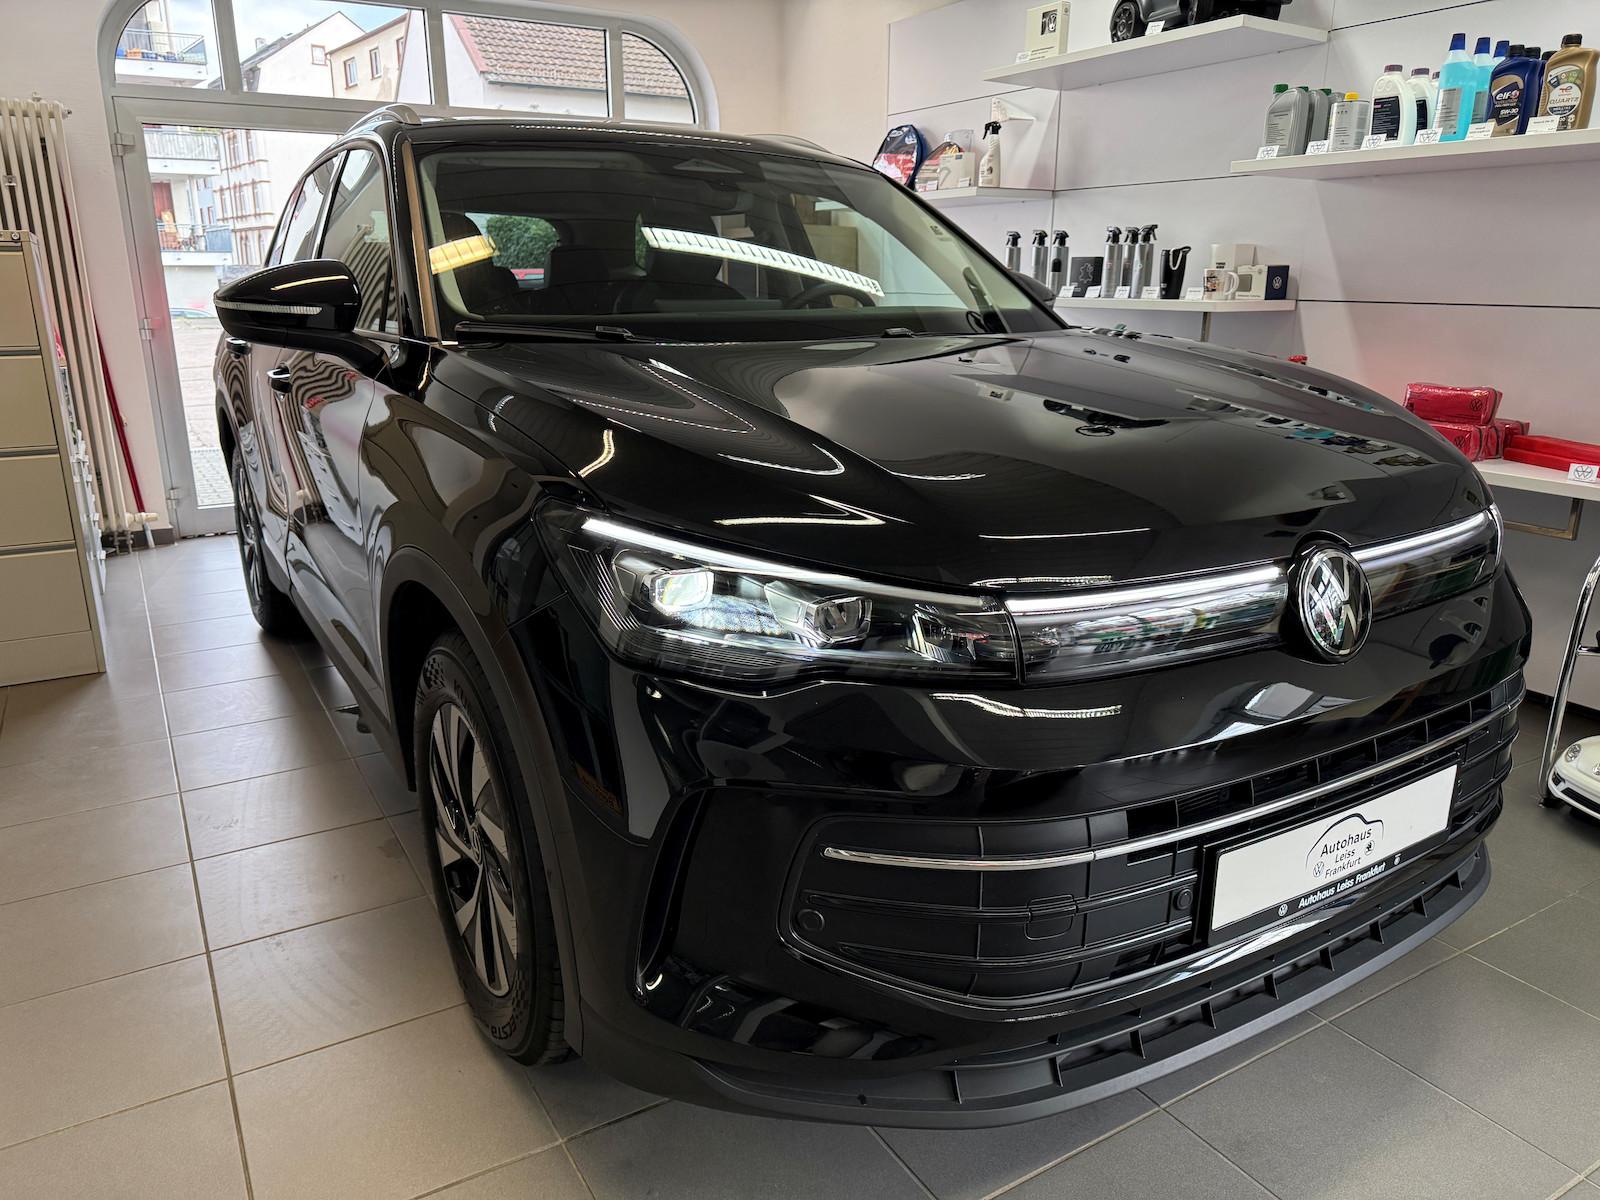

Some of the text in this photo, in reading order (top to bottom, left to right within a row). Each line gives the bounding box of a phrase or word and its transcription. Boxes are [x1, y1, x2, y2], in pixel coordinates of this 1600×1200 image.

[1496, 91, 1511, 100] elf
[1320, 828, 1372, 858] Autohaus
[1335, 849, 1356, 864] Leiss
[1324, 857, 1361, 879] Frankfurt
[1298, 886, 1336, 909] Autohaus
[1336, 878, 1355, 893] Leiss
[1355, 862, 1386, 884] Frankfurt
